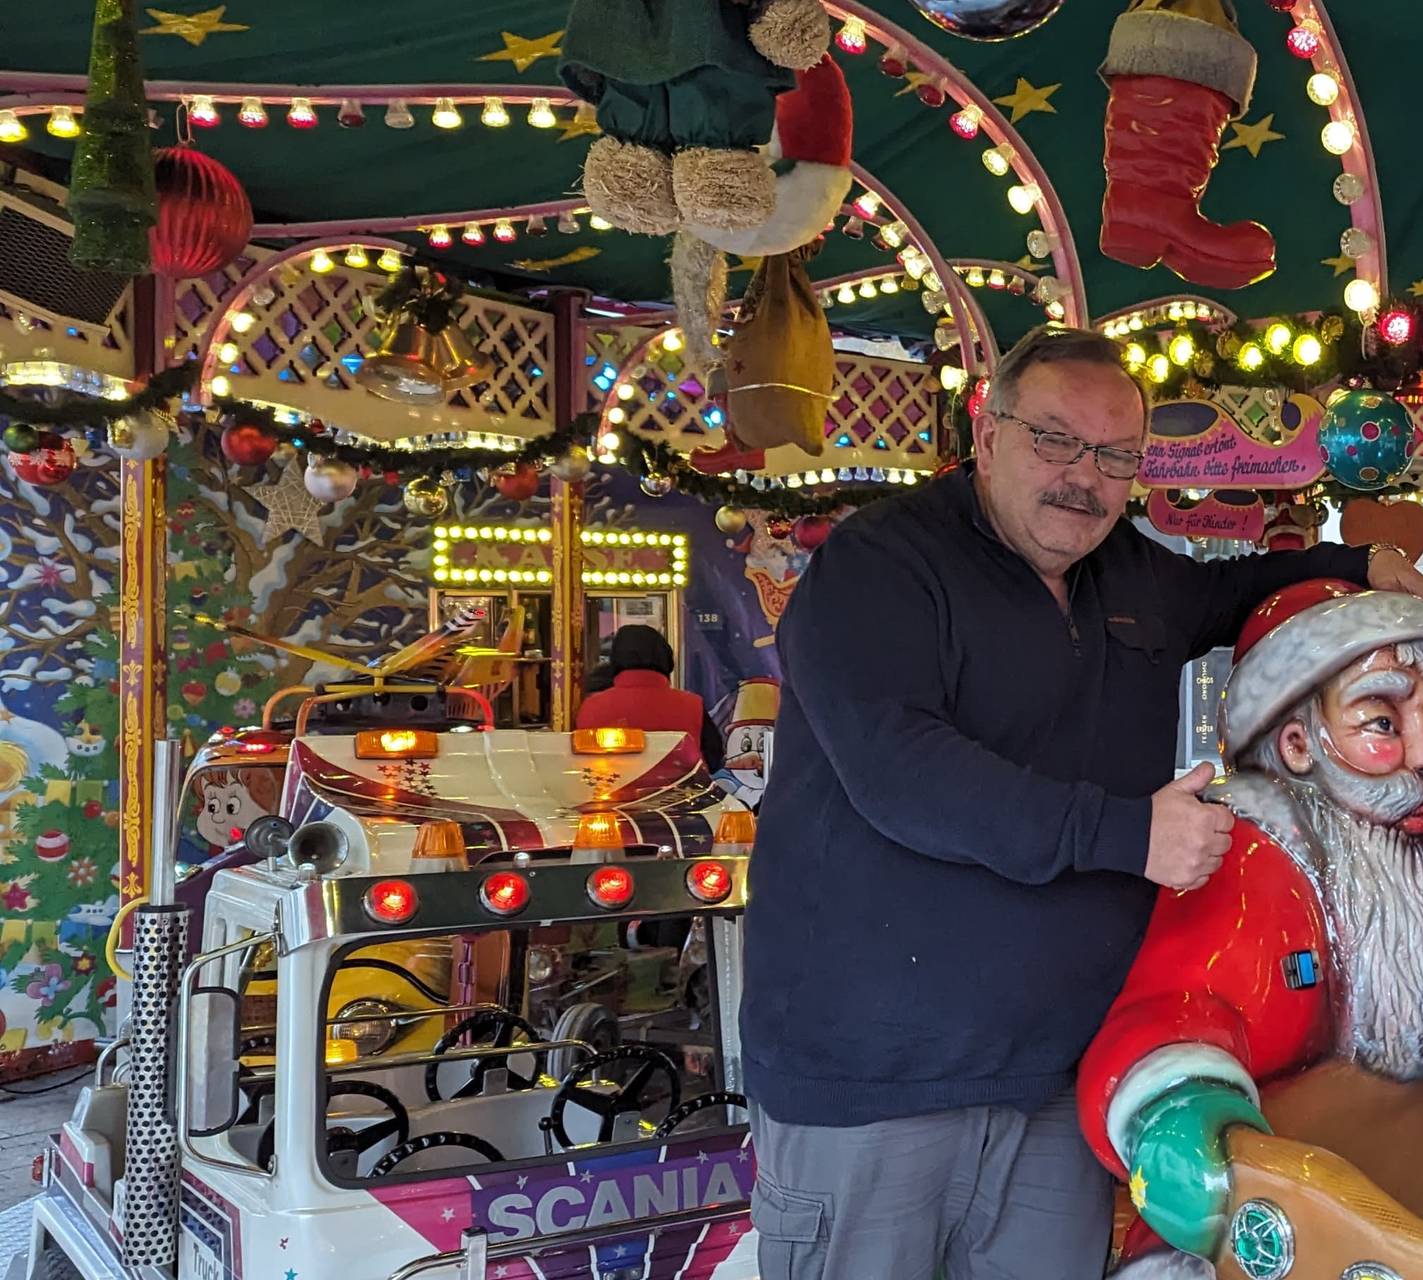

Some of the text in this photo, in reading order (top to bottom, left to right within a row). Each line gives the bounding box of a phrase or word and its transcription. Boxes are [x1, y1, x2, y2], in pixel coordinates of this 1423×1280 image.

[1168, 442, 1203, 462] Signal
[1144, 455, 1306, 481] Fahrbahn bitte freimachen.
[1185, 513, 1200, 532] für
[473, 545, 636, 571] KASE
[698, 613, 718, 623] 138
[487, 1162, 743, 1242] SCANIA
